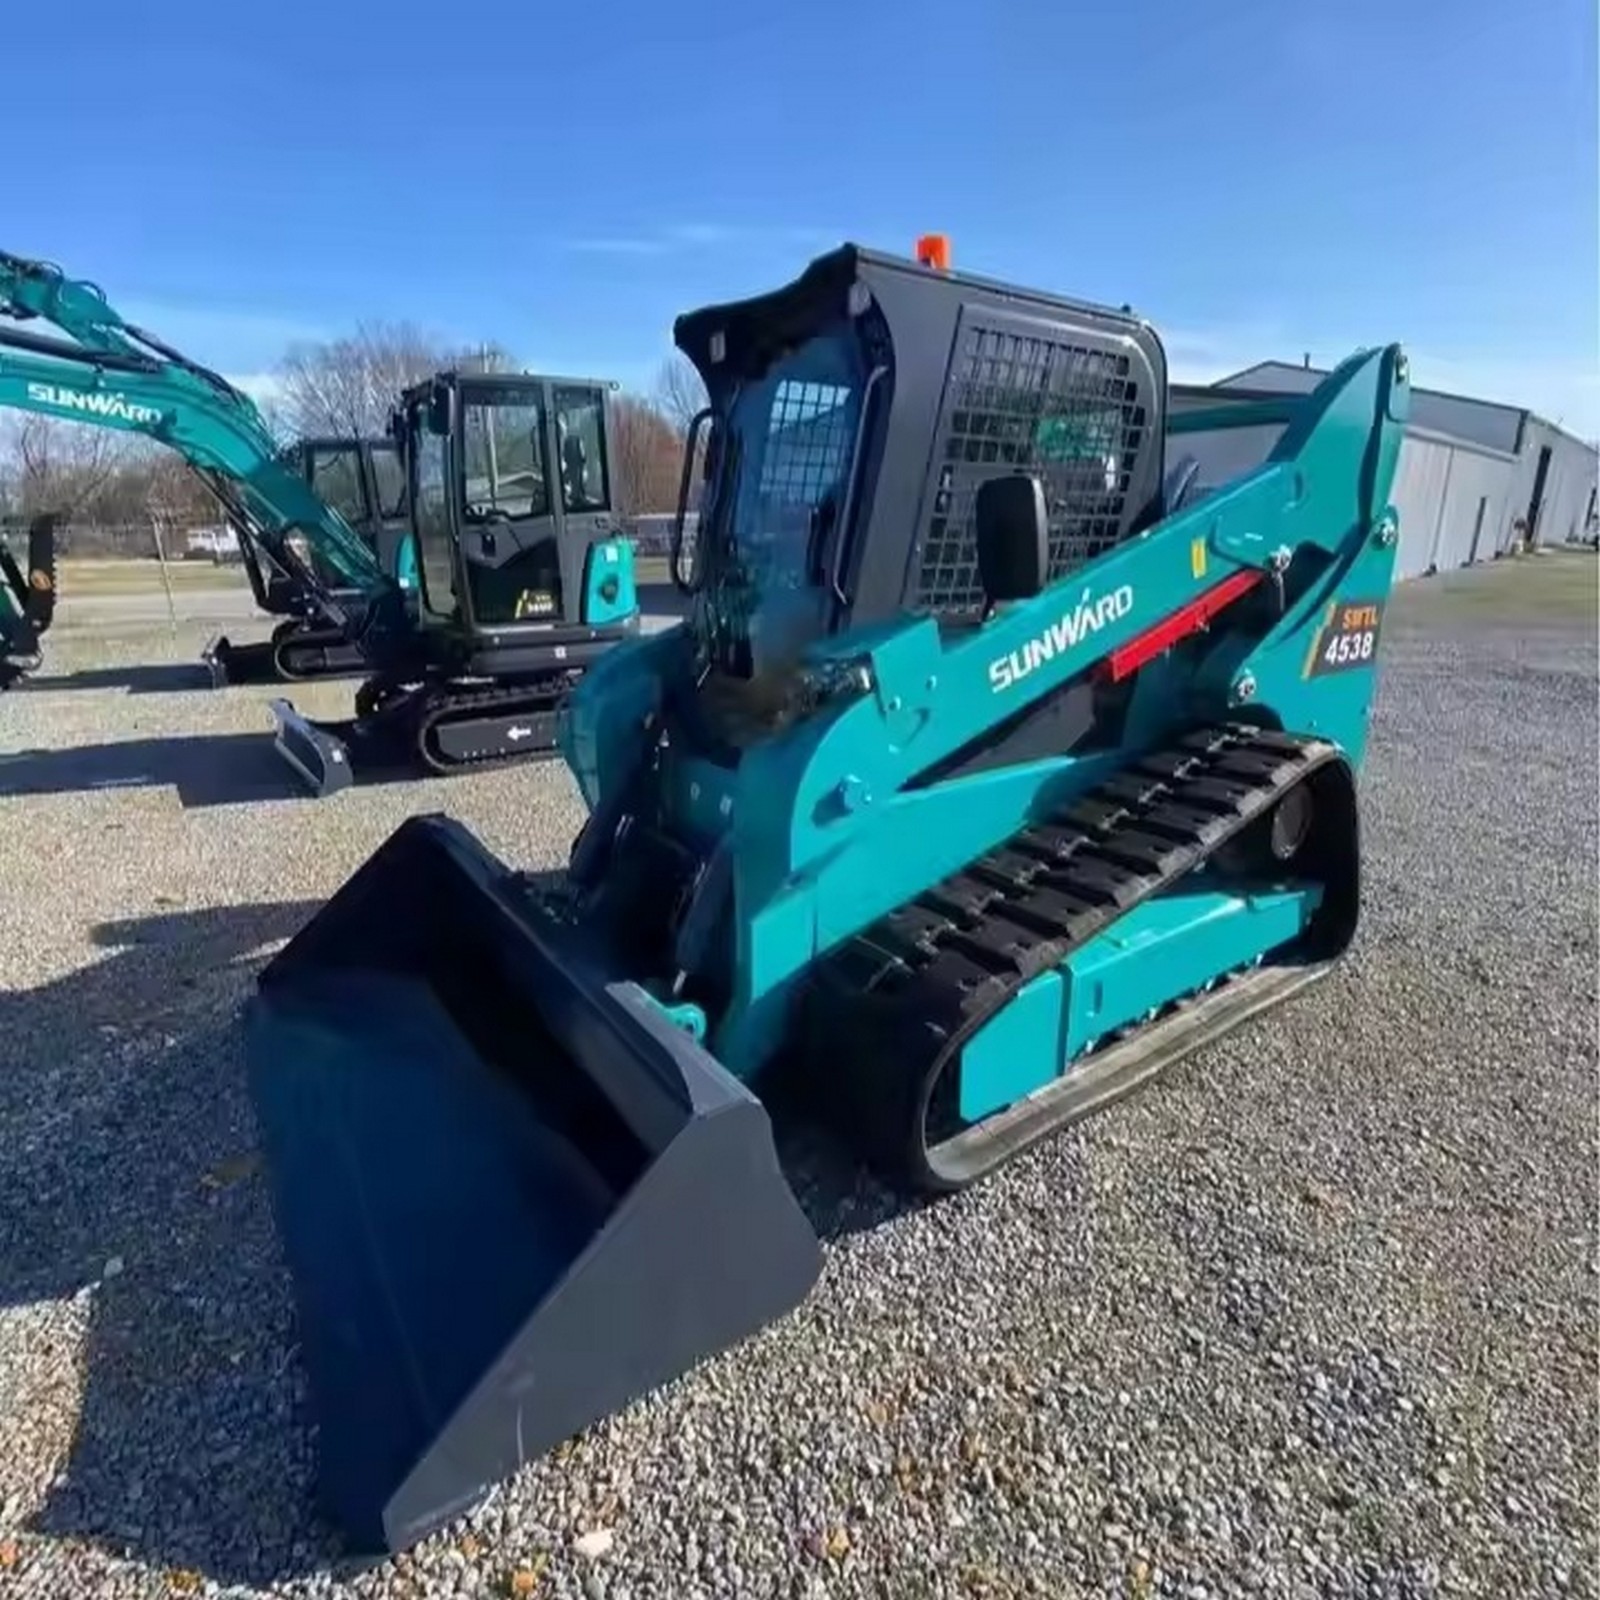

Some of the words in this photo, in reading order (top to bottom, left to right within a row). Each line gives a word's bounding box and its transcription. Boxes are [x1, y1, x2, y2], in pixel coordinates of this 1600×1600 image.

[28, 382, 162, 425] SUNWARD
[989, 586, 1133, 693] SUNWARD
[1325, 631, 1374, 665] 4538
